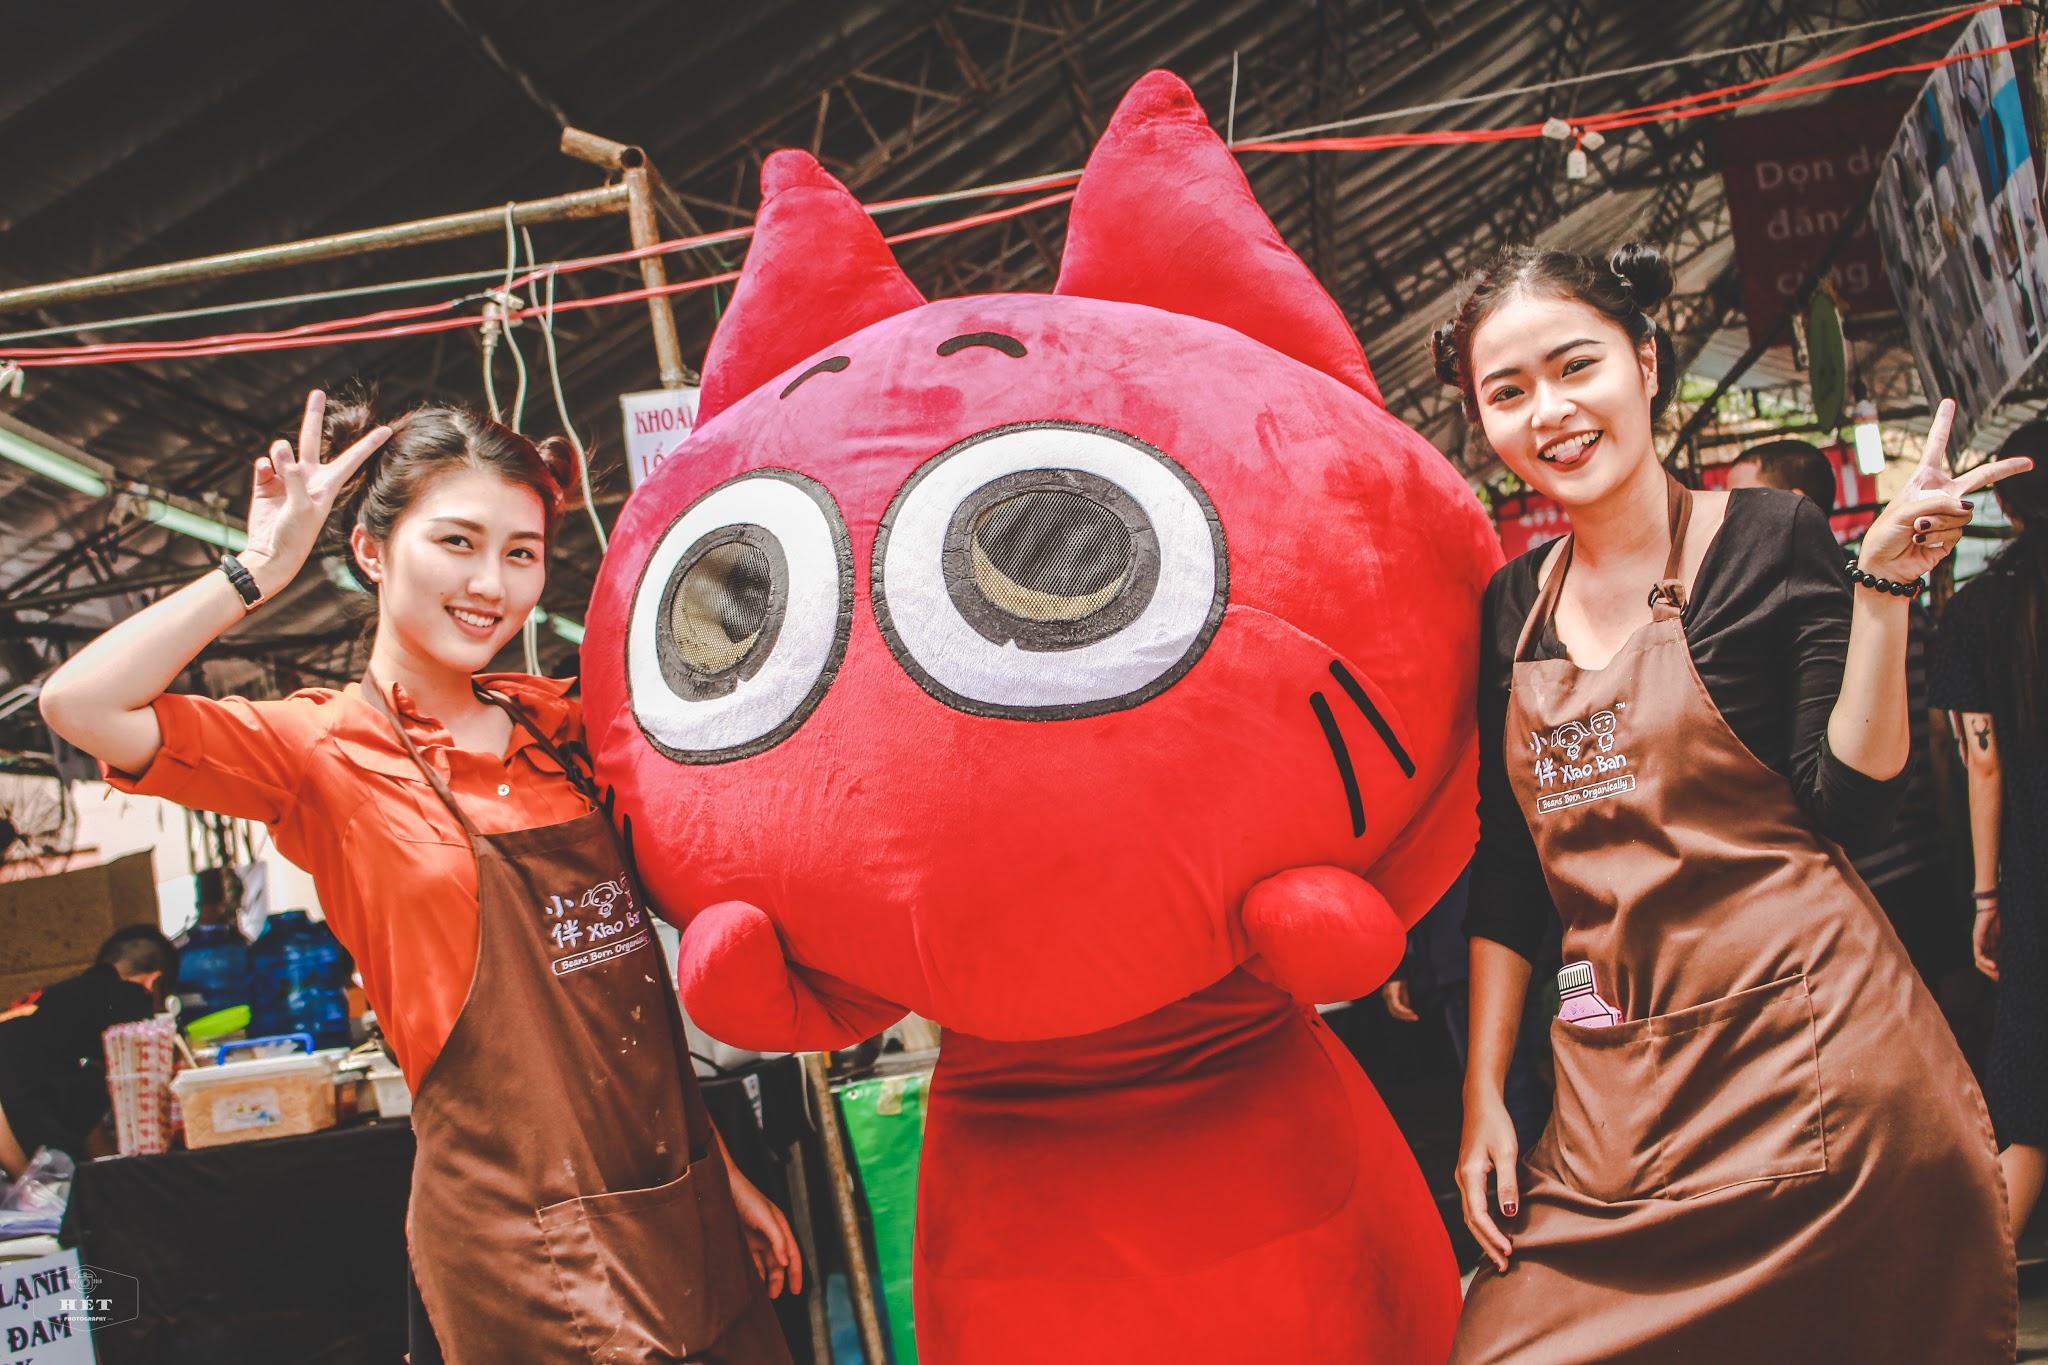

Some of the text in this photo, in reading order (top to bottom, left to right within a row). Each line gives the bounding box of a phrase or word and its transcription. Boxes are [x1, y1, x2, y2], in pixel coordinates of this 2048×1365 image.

[1755, 159, 1835, 193] Dọn
[1560, 753, 1627, 784] Xiao Ban
[1542, 779, 1628, 810] Beans Born Organically
[586, 920, 624, 942] Xiao
[561, 955, 589, 971] Beans
[590, 948, 613, 961] Born
[6, 1313, 72, 1353] ĐAM
